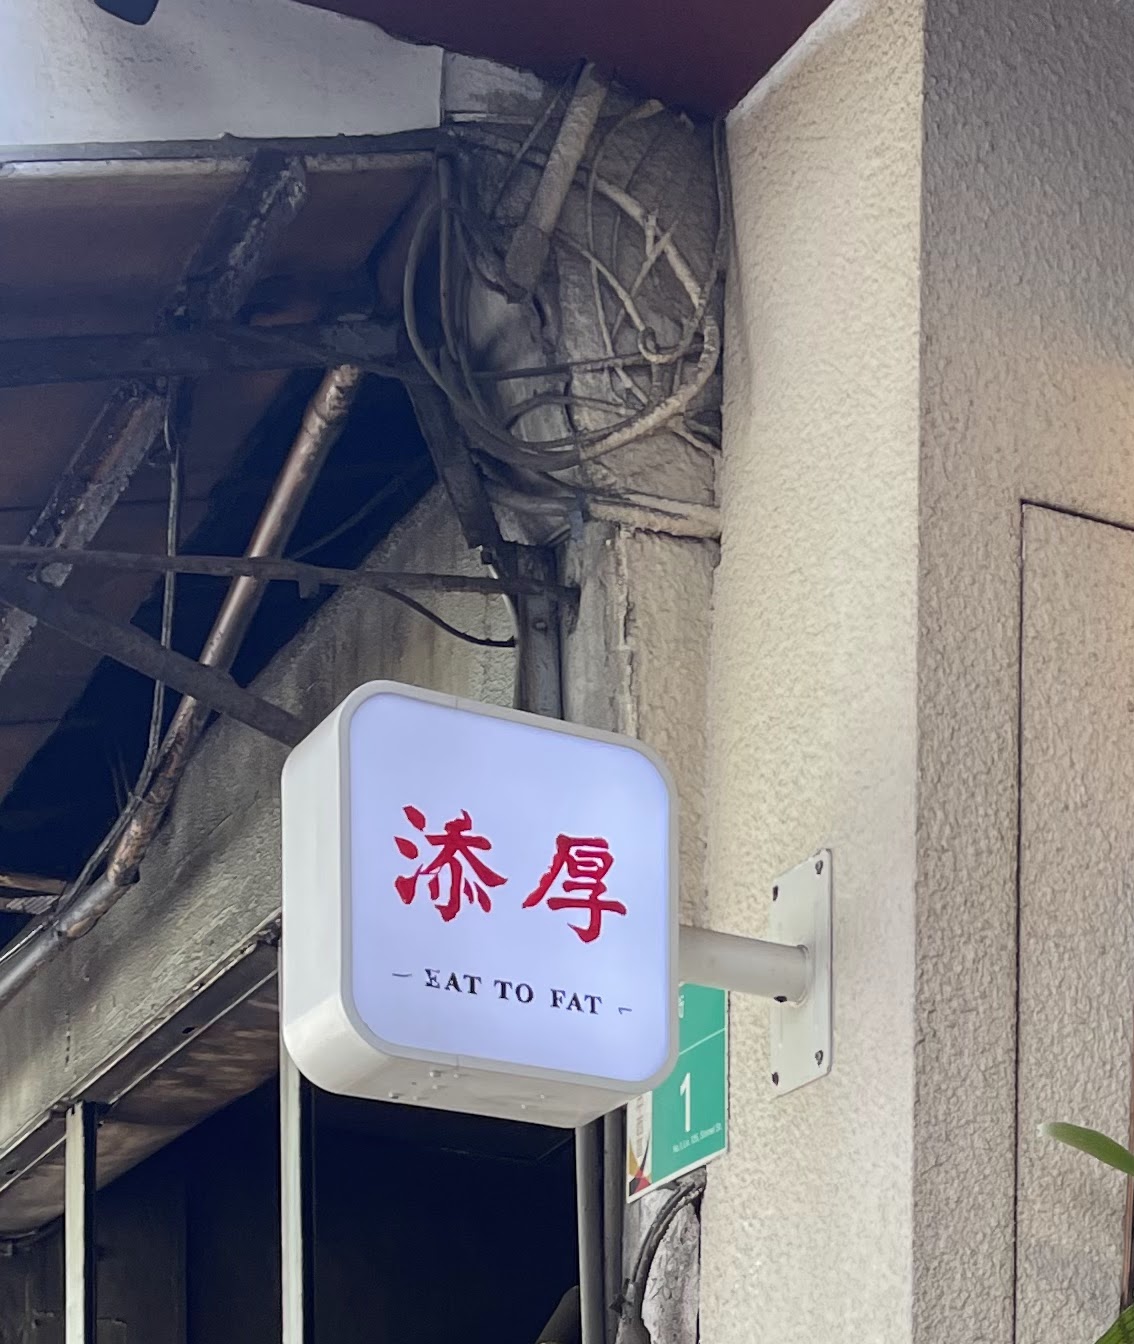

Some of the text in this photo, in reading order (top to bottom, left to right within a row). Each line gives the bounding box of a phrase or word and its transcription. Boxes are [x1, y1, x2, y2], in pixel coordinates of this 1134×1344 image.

[394, 805, 627, 943] 添厚
[424, 968, 602, 1014] EAT TO FAT
[679, 1072, 691, 1132] 1
